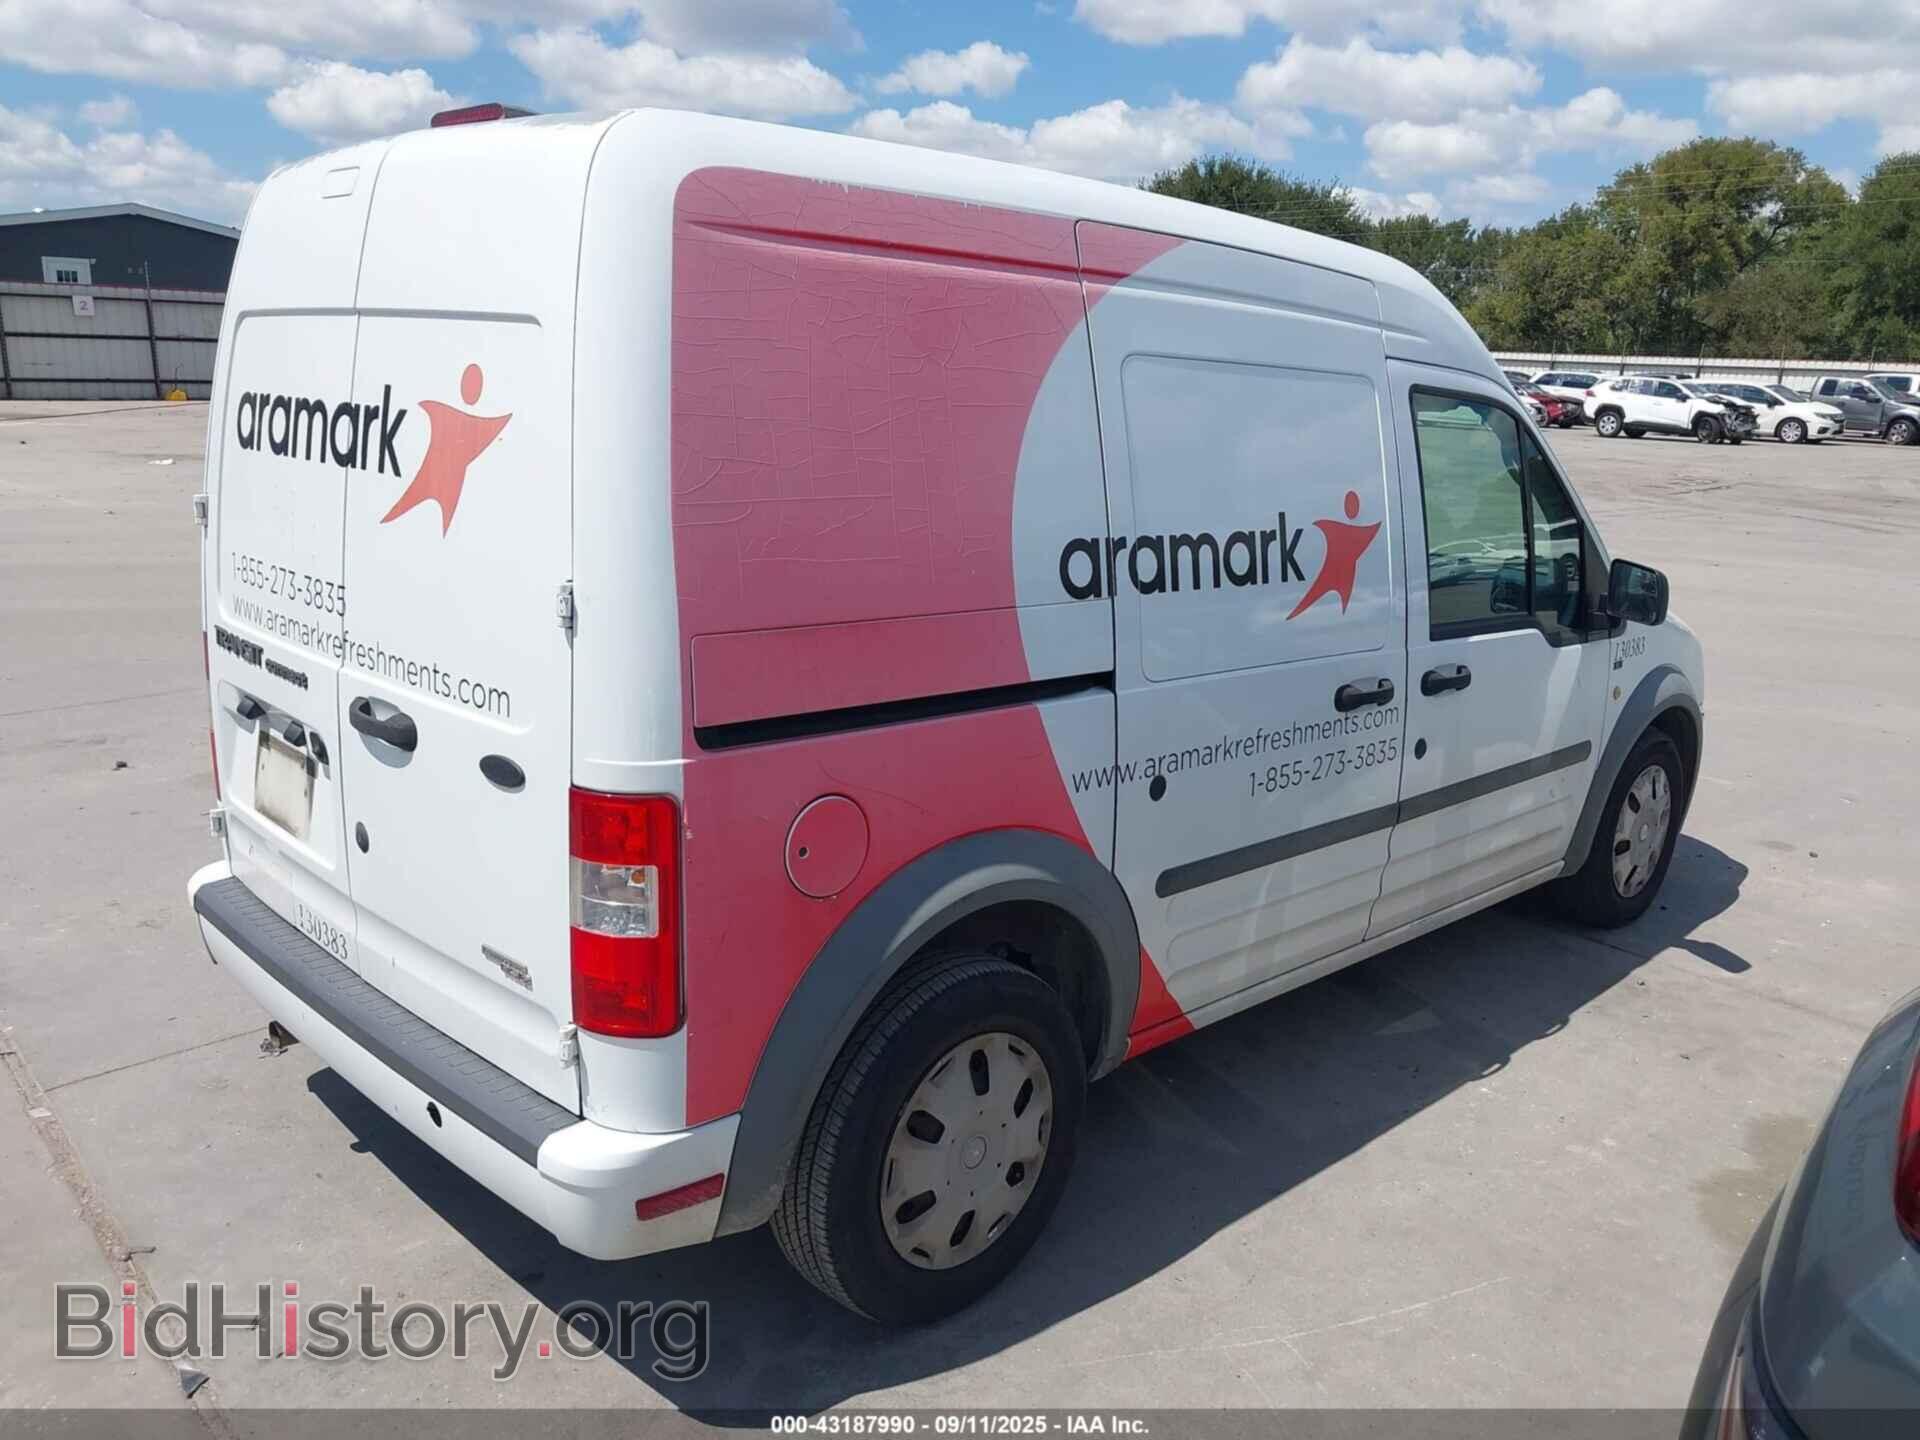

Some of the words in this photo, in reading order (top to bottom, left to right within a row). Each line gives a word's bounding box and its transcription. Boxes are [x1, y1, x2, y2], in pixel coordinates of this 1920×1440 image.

[237, 384, 408, 478] aramark
[231, 551, 346, 617] 1-855-273-3835
[1059, 511, 1306, 600] aramark
[232, 593, 511, 718] www.aramarkrefreshments.com
[1071, 705, 1399, 794] www.aramarkrefreshments.com
[1249, 737, 1398, 797] 1-855-273-3835
